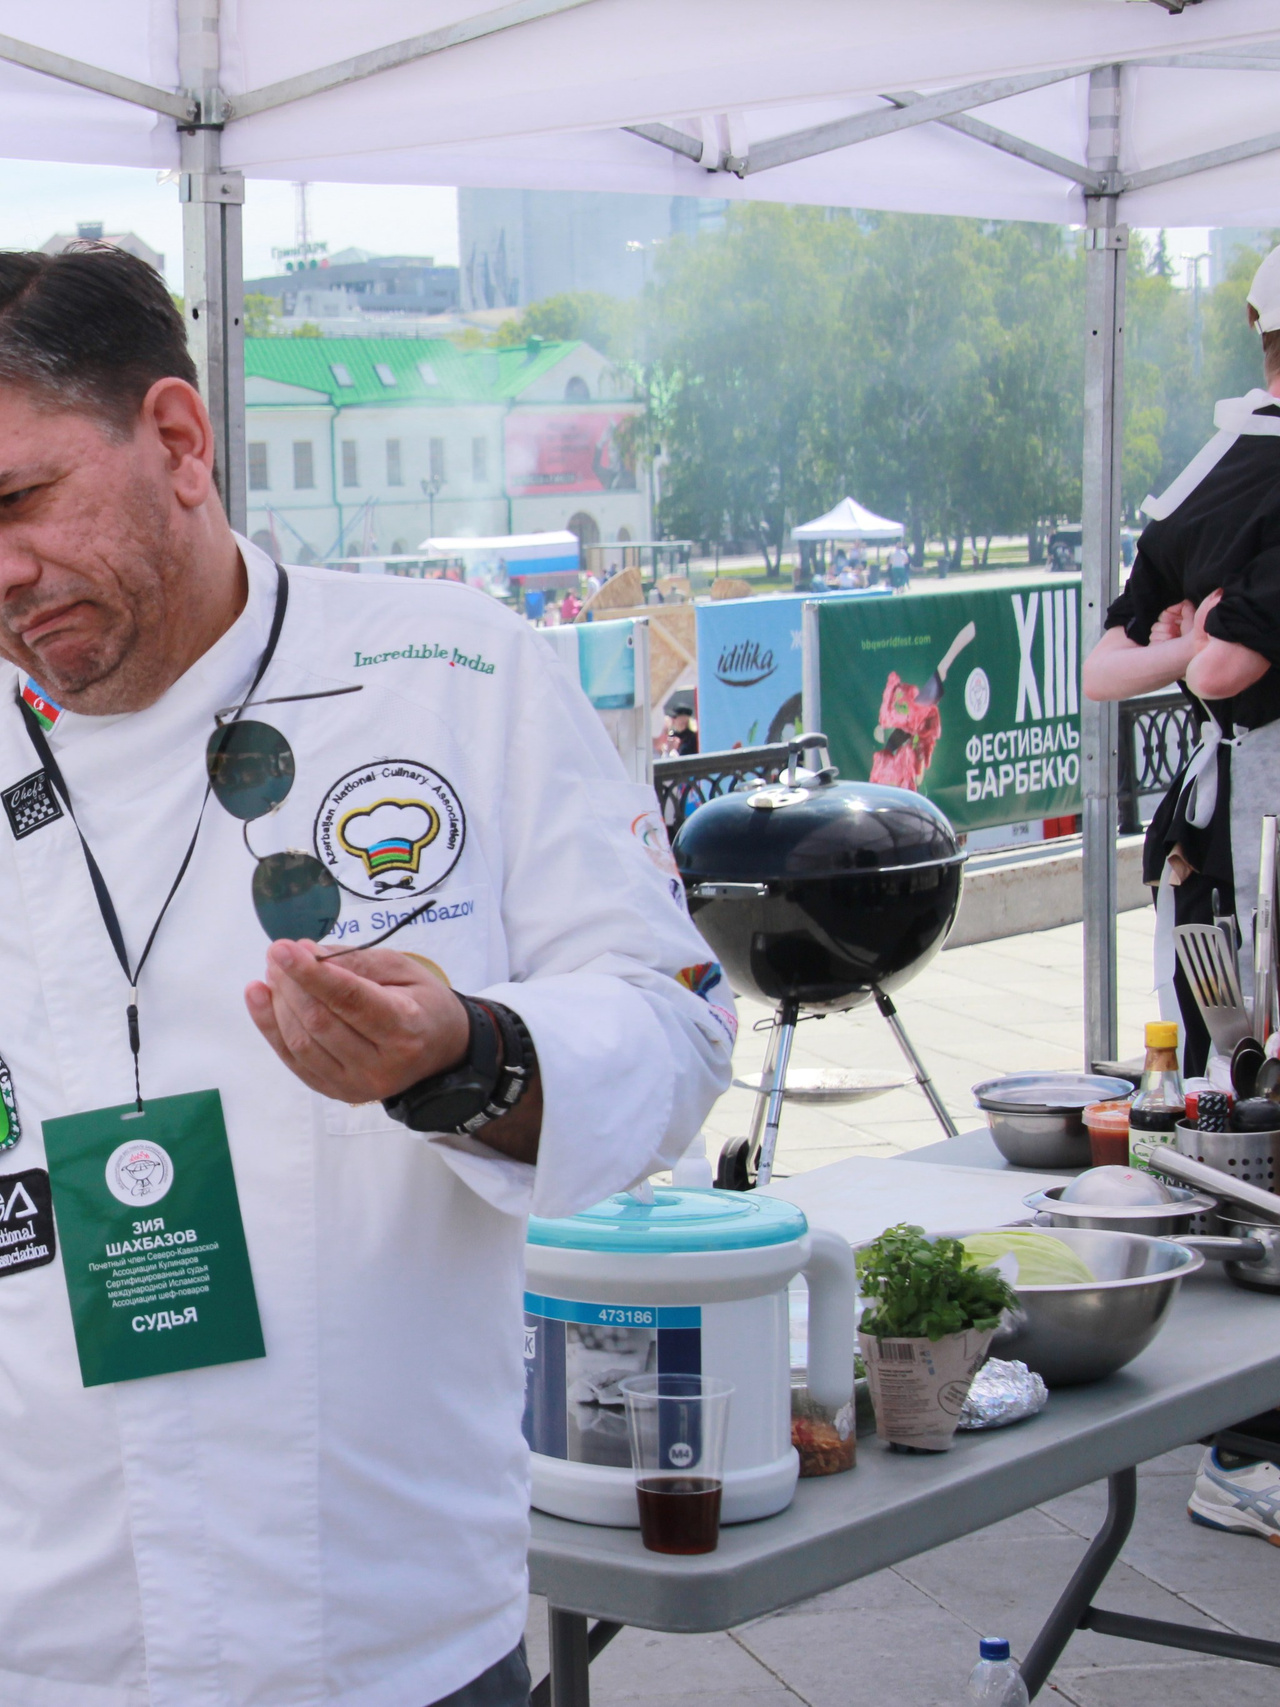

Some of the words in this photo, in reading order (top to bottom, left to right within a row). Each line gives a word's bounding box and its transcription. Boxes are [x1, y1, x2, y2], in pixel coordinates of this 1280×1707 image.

[354, 643, 449, 668] Incredible
[717, 639, 774, 673] idilika
[1011, 588, 1079, 723] XIII
[965, 721, 1080, 765] ФЕСТИВАЛЬ
[966, 753, 1080, 802] БАРБЕКЮ
[320, 808, 339, 867] Azerbaijan
[332, 771, 376, 805] National
[381, 766, 430, 786] Culinary
[431, 785, 461, 851] Association
[132, 1217, 165, 1235] ЗИЯ
[105, 1229, 198, 1257] ШАХБАЗОВ
[88, 1258, 126, 1272] Почетный
[127, 1255, 146, 1265] член
[146, 1242, 219, 1261] Северо-Кавказской
[112, 1263, 157, 1278] Ассоциации
[158, 1256, 199, 1271] Кулинаров
[105, 1267, 186, 1289] Сертифицированный
[186, 1264, 209, 1276] судья
[107, 1281, 168, 1299] международной
[168, 1274, 211, 1288] Исламской
[112, 1293, 157, 1308] Ассоциации
[158, 1284, 210, 1301] шеф-поваров
[131, 1306, 198, 1333] СУДЬЯ
[598, 1309, 653, 1324] 473186
[671, 1448, 690, 1460] M4
